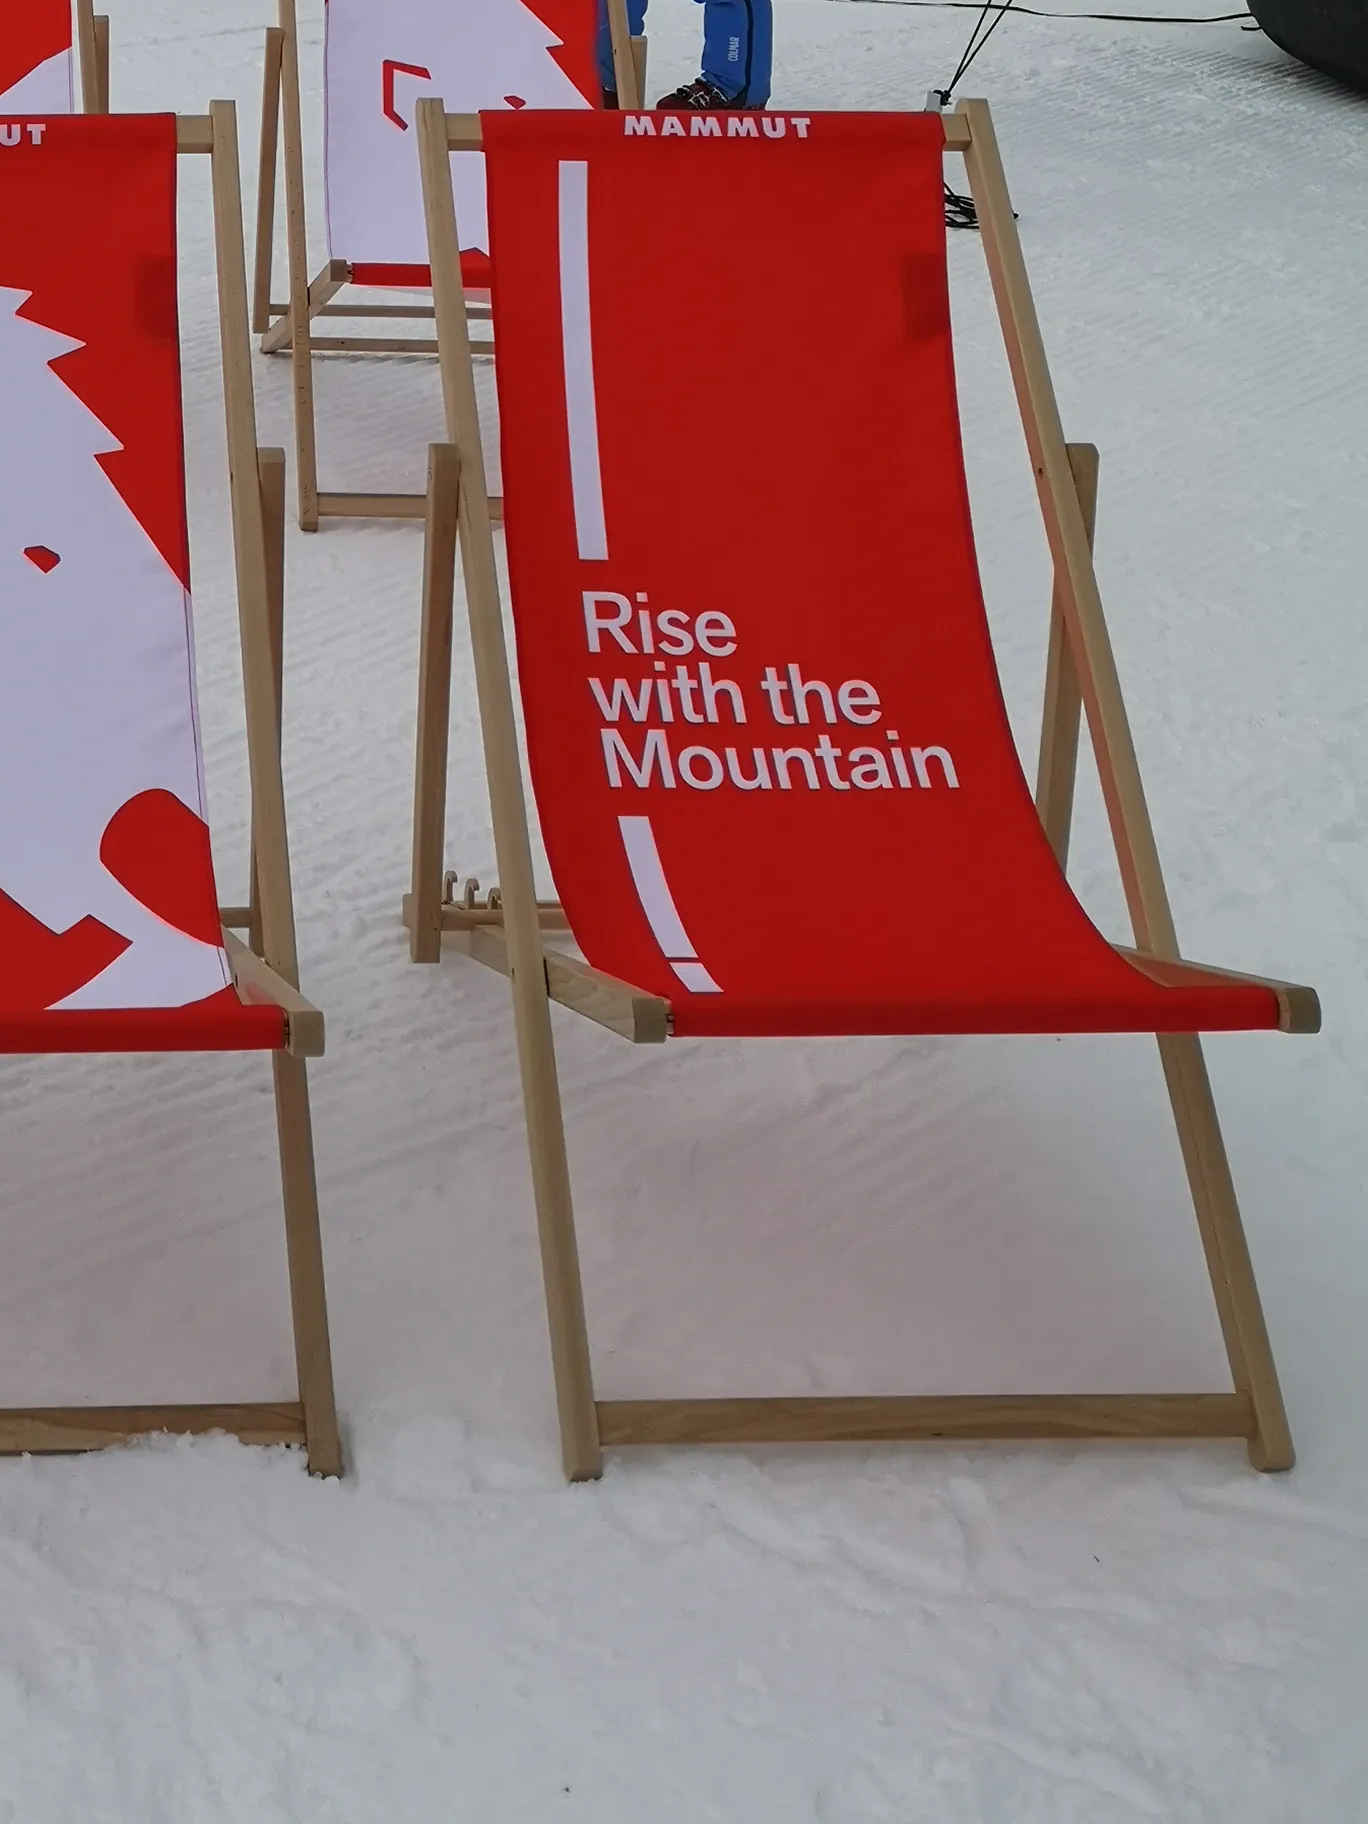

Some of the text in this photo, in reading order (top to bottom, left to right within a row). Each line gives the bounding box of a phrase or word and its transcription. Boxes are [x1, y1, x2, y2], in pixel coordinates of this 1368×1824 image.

[624, 114, 812, 139] MAMMUT
[582, 590, 738, 657] Rise
[587, 660, 883, 727] with the
[600, 728, 960, 791] Mountain
